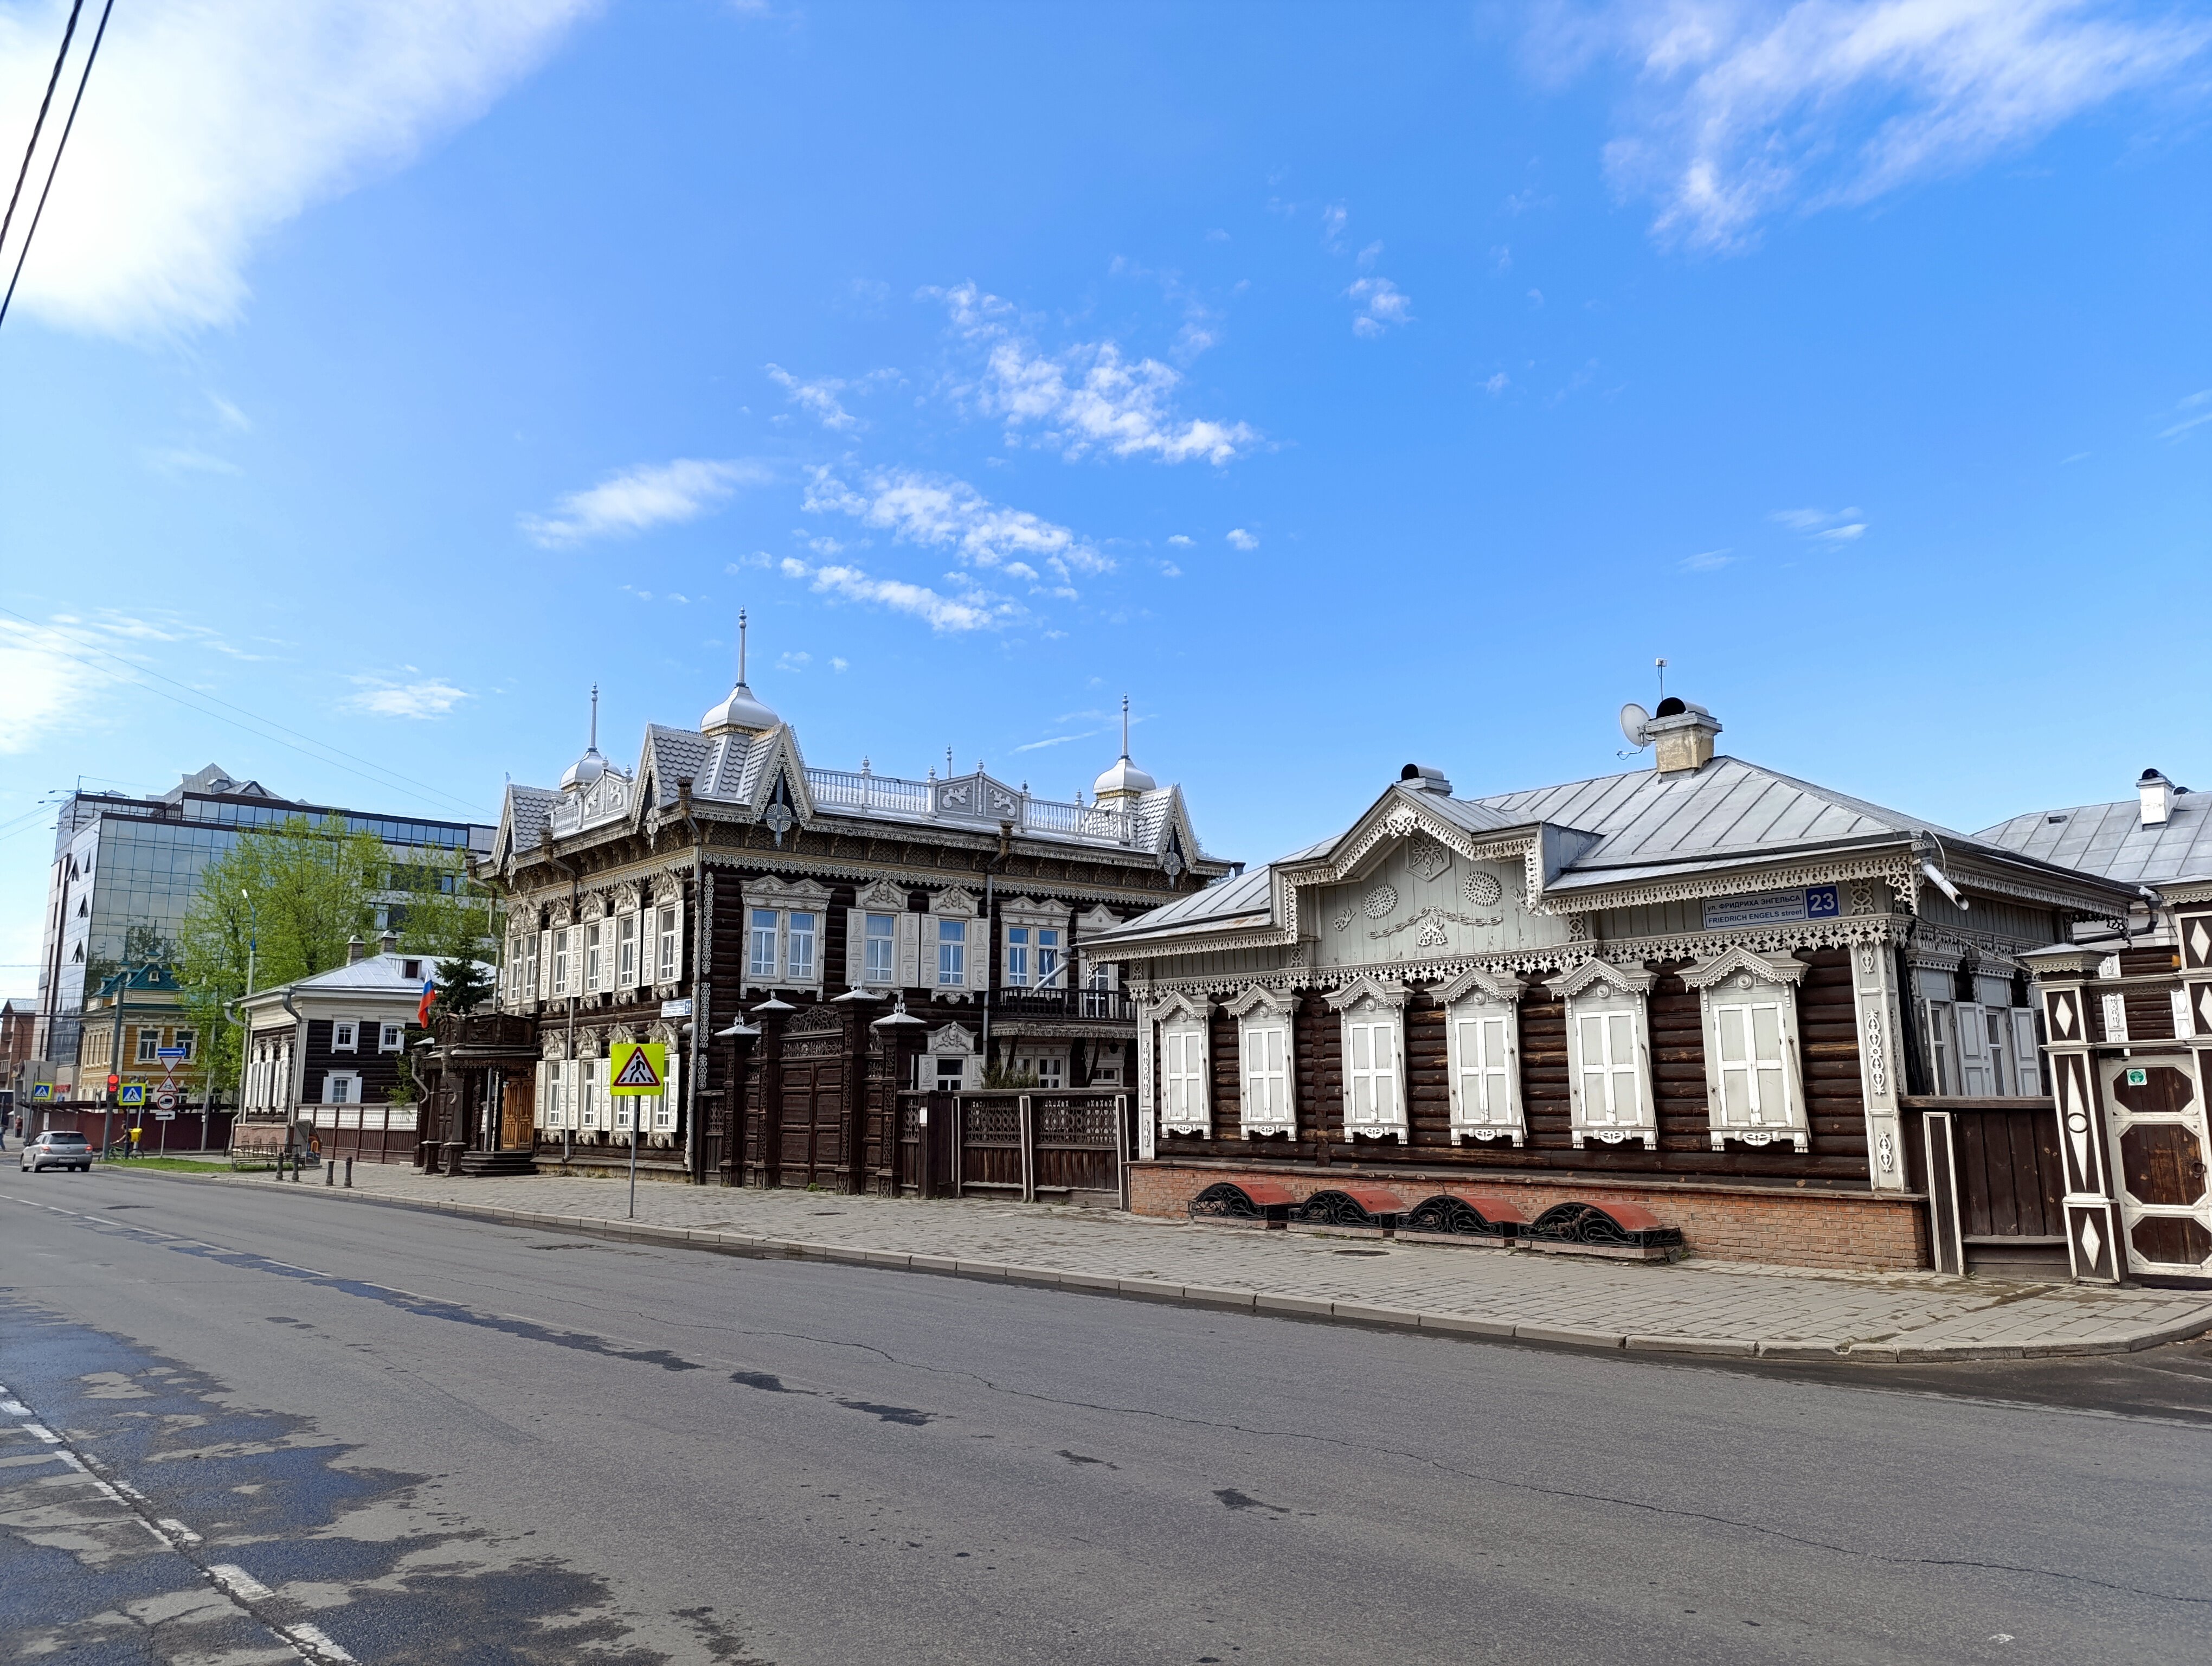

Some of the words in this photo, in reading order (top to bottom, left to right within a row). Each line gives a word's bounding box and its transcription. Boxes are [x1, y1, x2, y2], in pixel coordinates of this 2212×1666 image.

[1719, 900, 1759, 909] ФРИДРИХА
[1761, 895, 1801, 905] ЭНГЕЛЬСА
[1810, 893, 1835, 911] 23
[1708, 914, 1747, 924] FRIEDRICH
[1749, 911, 1779, 920] ENGELS
[685, 1003, 691, 1011] 21
